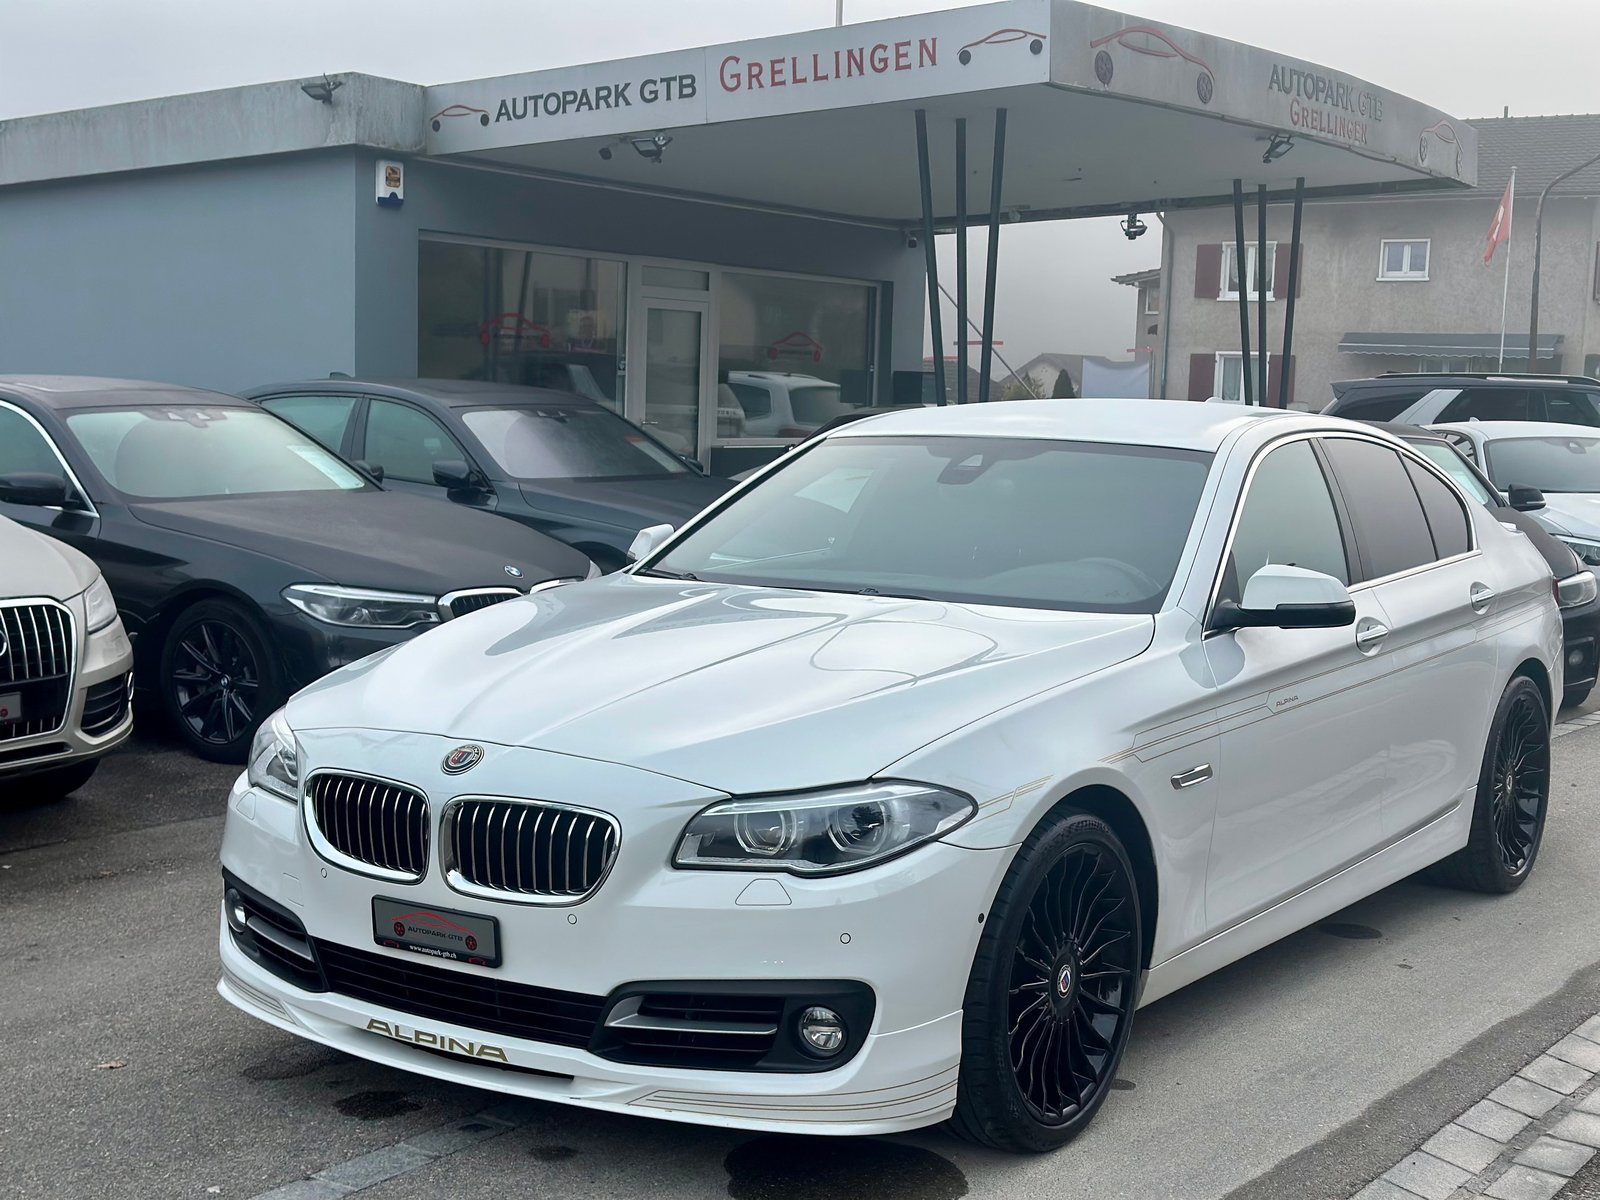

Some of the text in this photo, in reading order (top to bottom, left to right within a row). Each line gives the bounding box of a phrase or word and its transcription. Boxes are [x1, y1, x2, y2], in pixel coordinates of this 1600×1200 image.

[719, 37, 939, 93] GRELLINGEN
[495, 73, 697, 122] AUTOPARK GTB
[1268, 63, 1384, 122] AUTOPARK GTB
[1289, 96, 1369, 145] GRELLINGEN
[1276, 695, 1299, 707] ALPINA
[407, 925, 464, 942] AUTOPARK-GTB
[409, 944, 457, 959] www.autopark-gtb.ch
[366, 1018, 509, 1062] ALPINA
